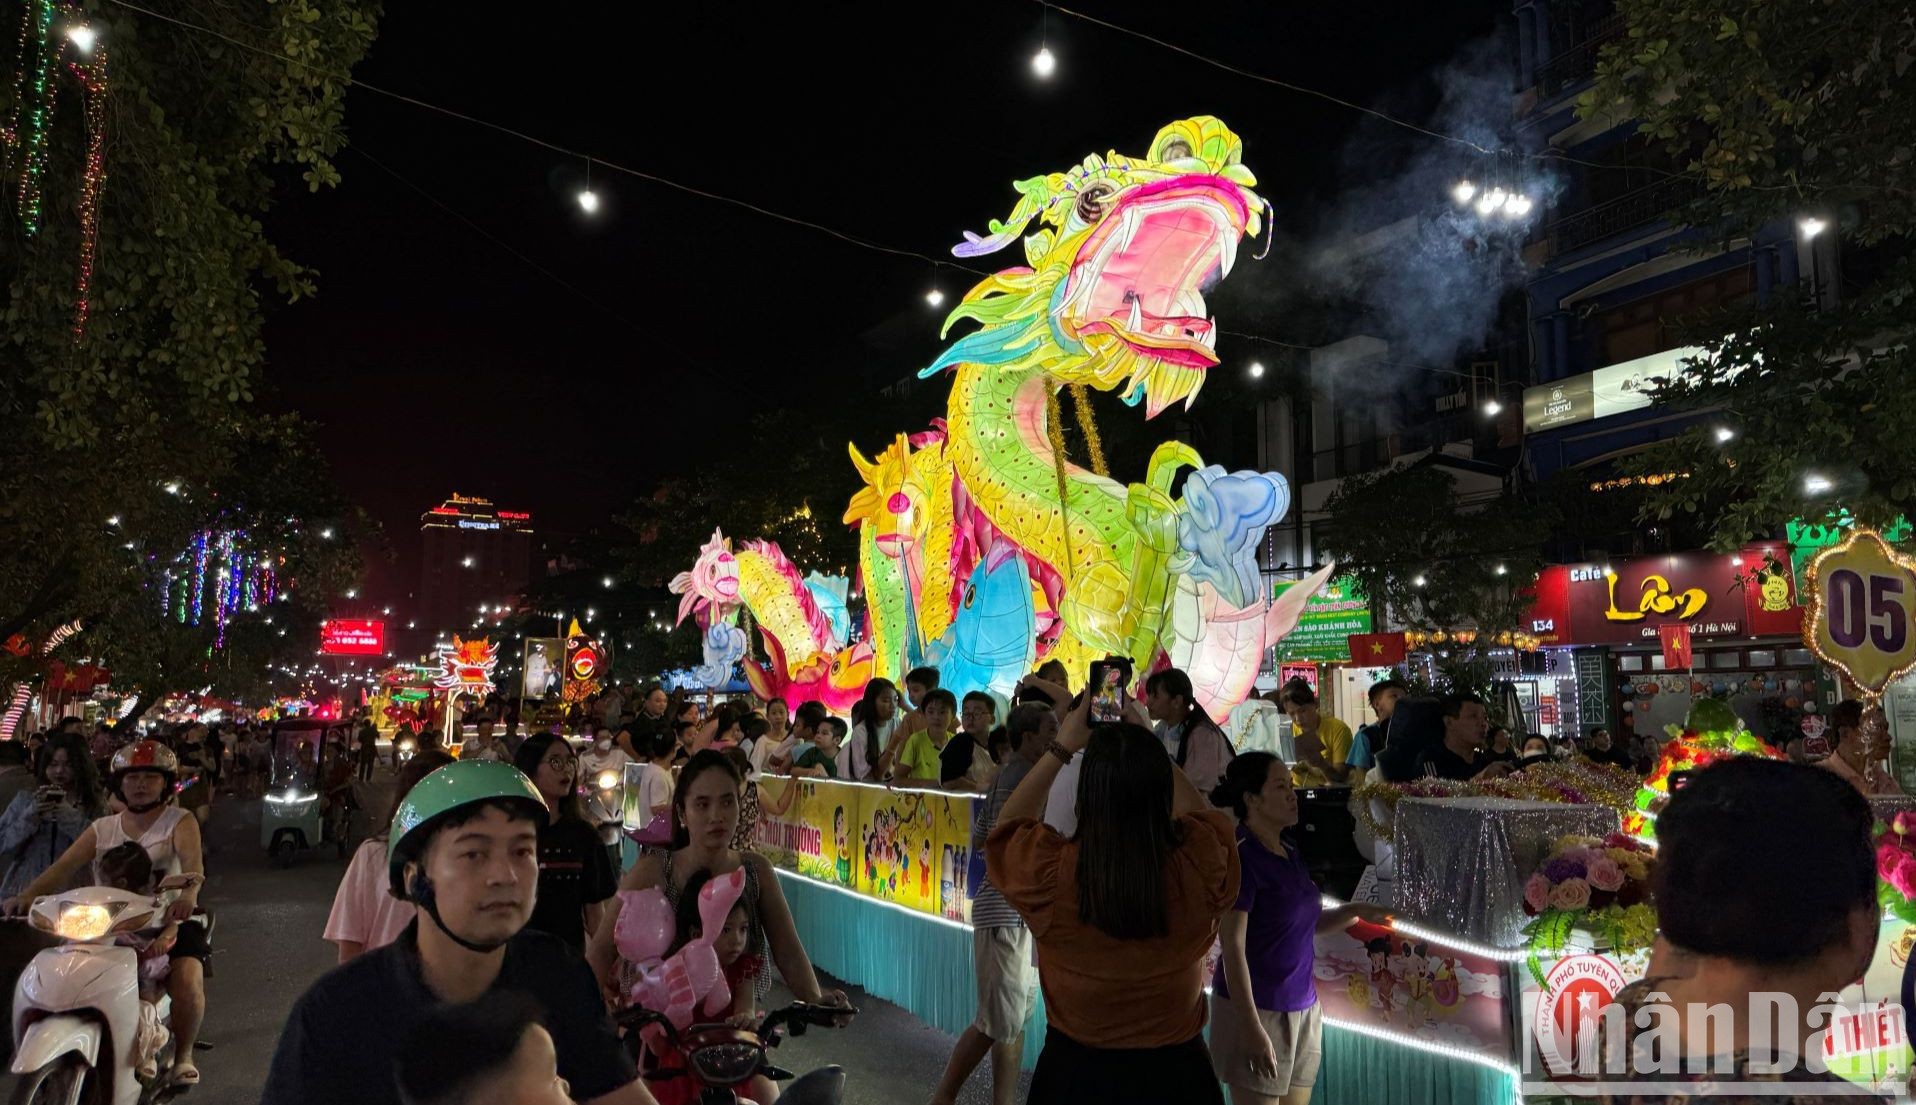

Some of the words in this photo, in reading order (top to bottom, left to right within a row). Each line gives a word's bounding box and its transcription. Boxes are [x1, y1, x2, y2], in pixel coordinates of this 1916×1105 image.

[1544, 401, 1572, 416] Legend
[1570, 566, 1601, 582] Café
[1827, 568, 1907, 653] 05
[1318, 621, 1346, 631] KHÁNH
[1533, 620, 1554, 632] 134
[1698, 625, 1703, 633] 1
[1706, 624, 1718, 634] Hà
[1720, 623, 1737, 634] Nội
[765, 817, 781, 847] MÔI
[784, 821, 821, 857] TRƯỜNG
[1556, 962, 1575, 987] PHỐ
[1576, 961, 1610, 981] TUYÊN
[1839, 997, 1901, 1053] THIẾT
